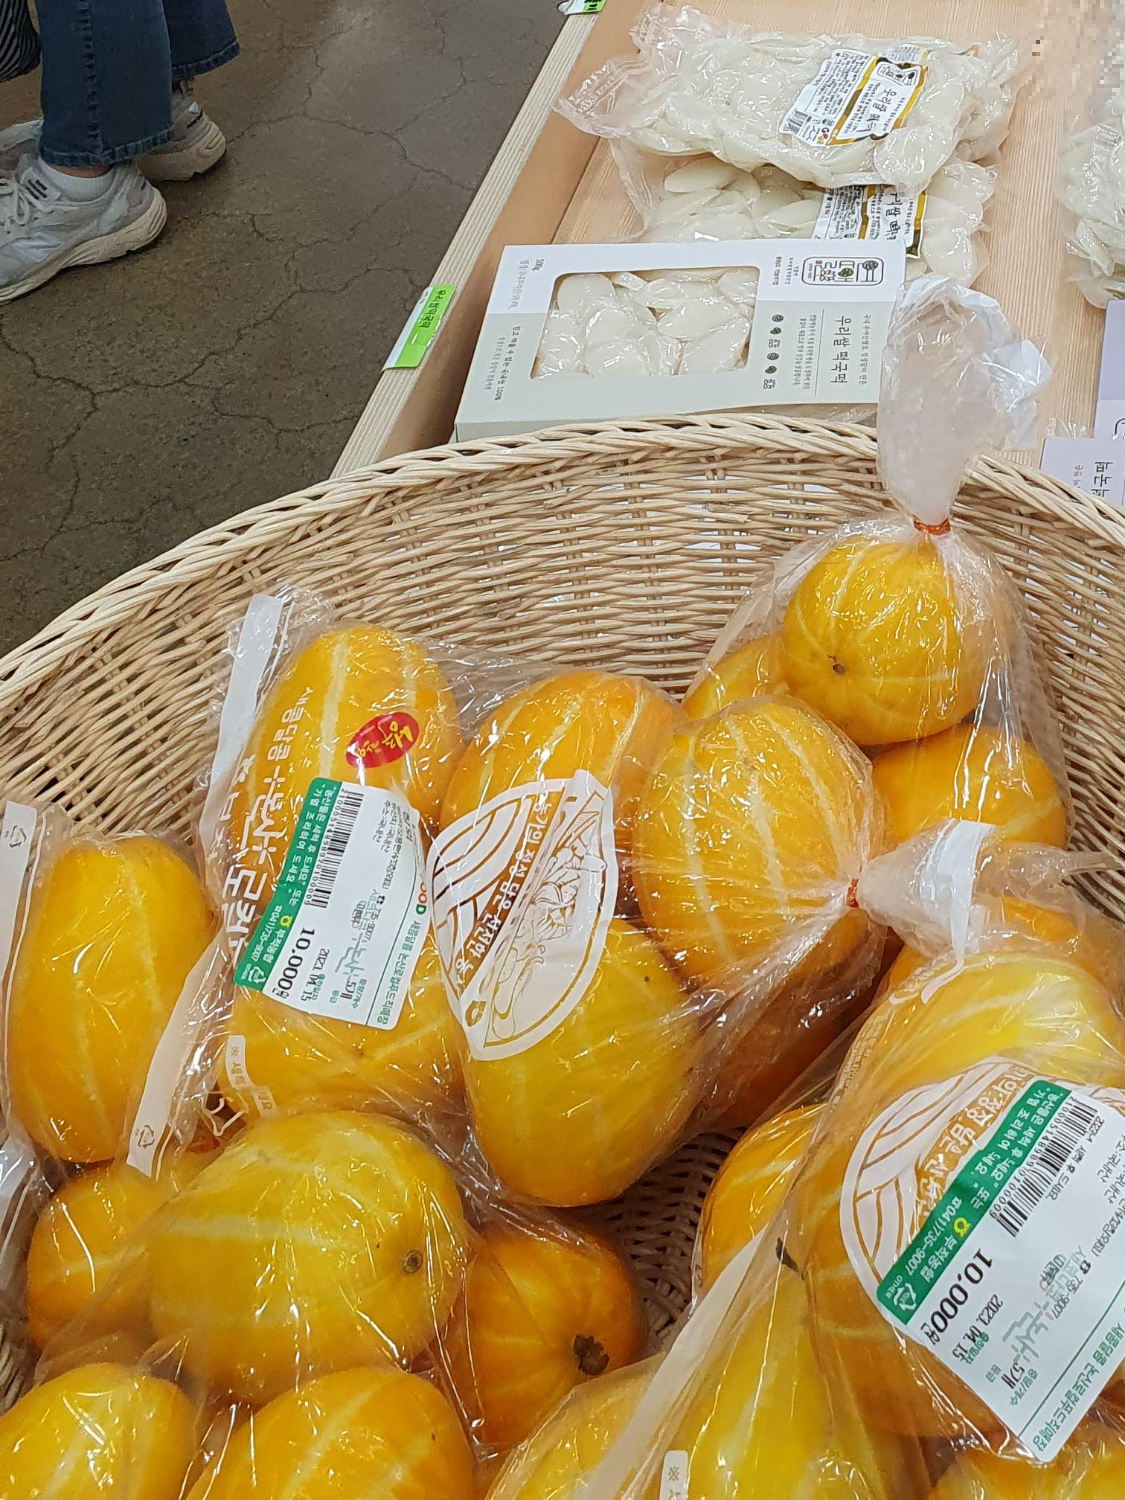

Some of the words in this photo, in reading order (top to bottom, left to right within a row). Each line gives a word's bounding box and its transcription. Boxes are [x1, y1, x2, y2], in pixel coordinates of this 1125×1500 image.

[831, 315, 852, 347] 우리쌀
[829, 350, 849, 384] 떡국떡
[263, 926, 286, 965] 부적농협
[270, 923, 315, 1001] 10,000원
[299, 990, 312, 1003] 15
[375, 951, 410, 1025] 논산로컬푸드직매장
[994, 1105, 1033, 1153] 조리하여
[1015, 1124, 1037, 1148] 세척
[1007, 1143, 1024, 1160] 후
[967, 1184, 992, 1212] 또는
[916, 1231, 960, 1283] 부적농협
[915, 1245, 997, 1348] 10,000원
[972, 1292, 1004, 1328] 2023.
[1047, 1273, 1084, 1319] 735-9007
[957, 1323, 982, 1351] 04.
[949, 1348, 965, 1362] 15
[998, 1359, 1027, 1389] 5개
